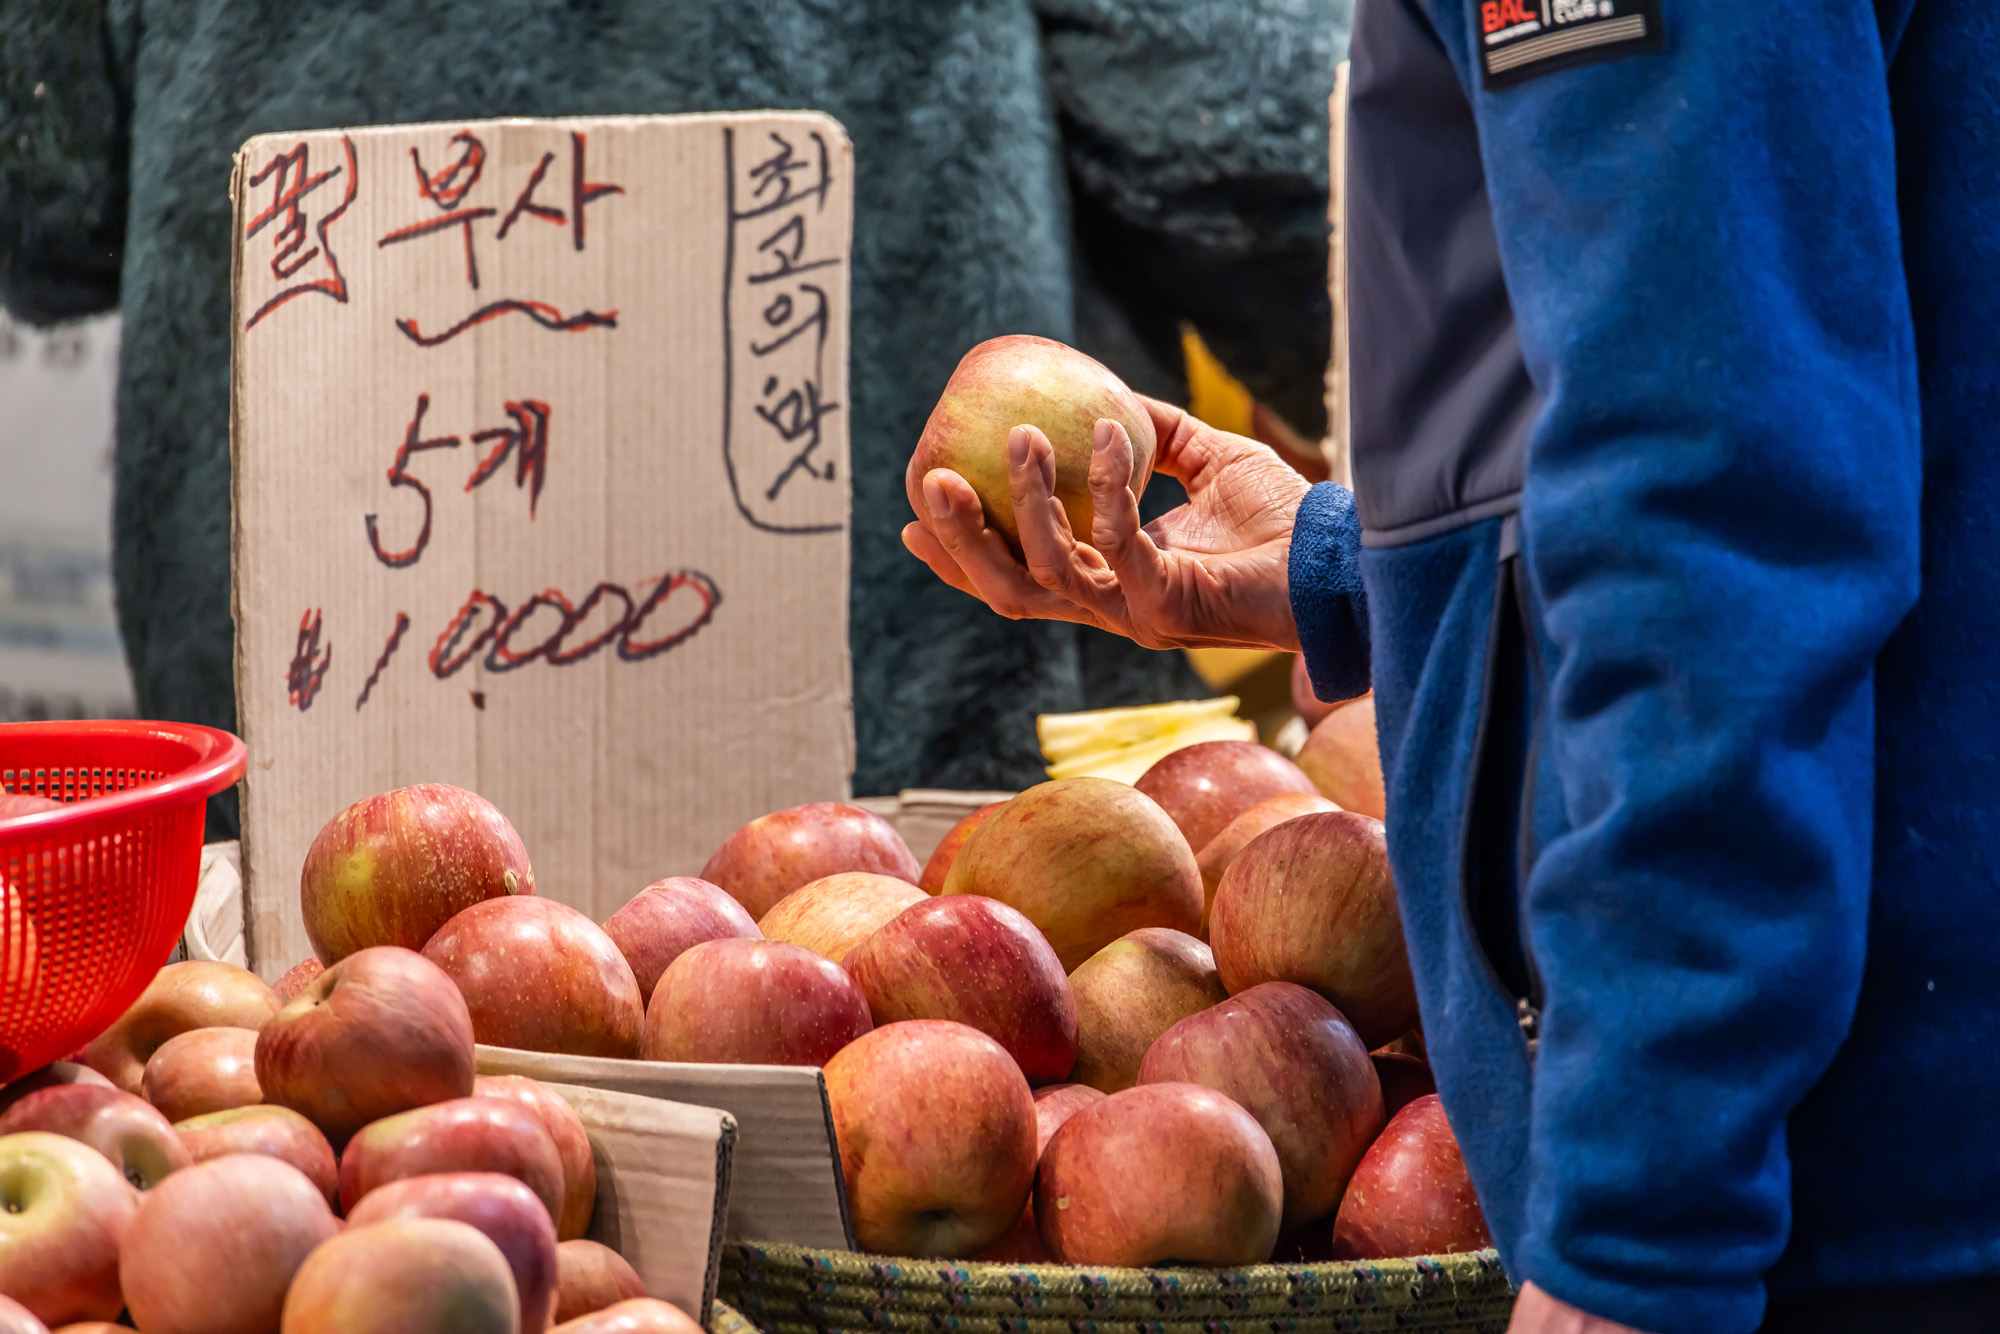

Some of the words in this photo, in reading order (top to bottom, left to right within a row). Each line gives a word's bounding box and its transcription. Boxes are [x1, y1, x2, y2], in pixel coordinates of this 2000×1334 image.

[1481, 0, 1537, 33] BAC
[378, 130, 625, 290] 부사
[745, 131, 841, 380] 최고의
